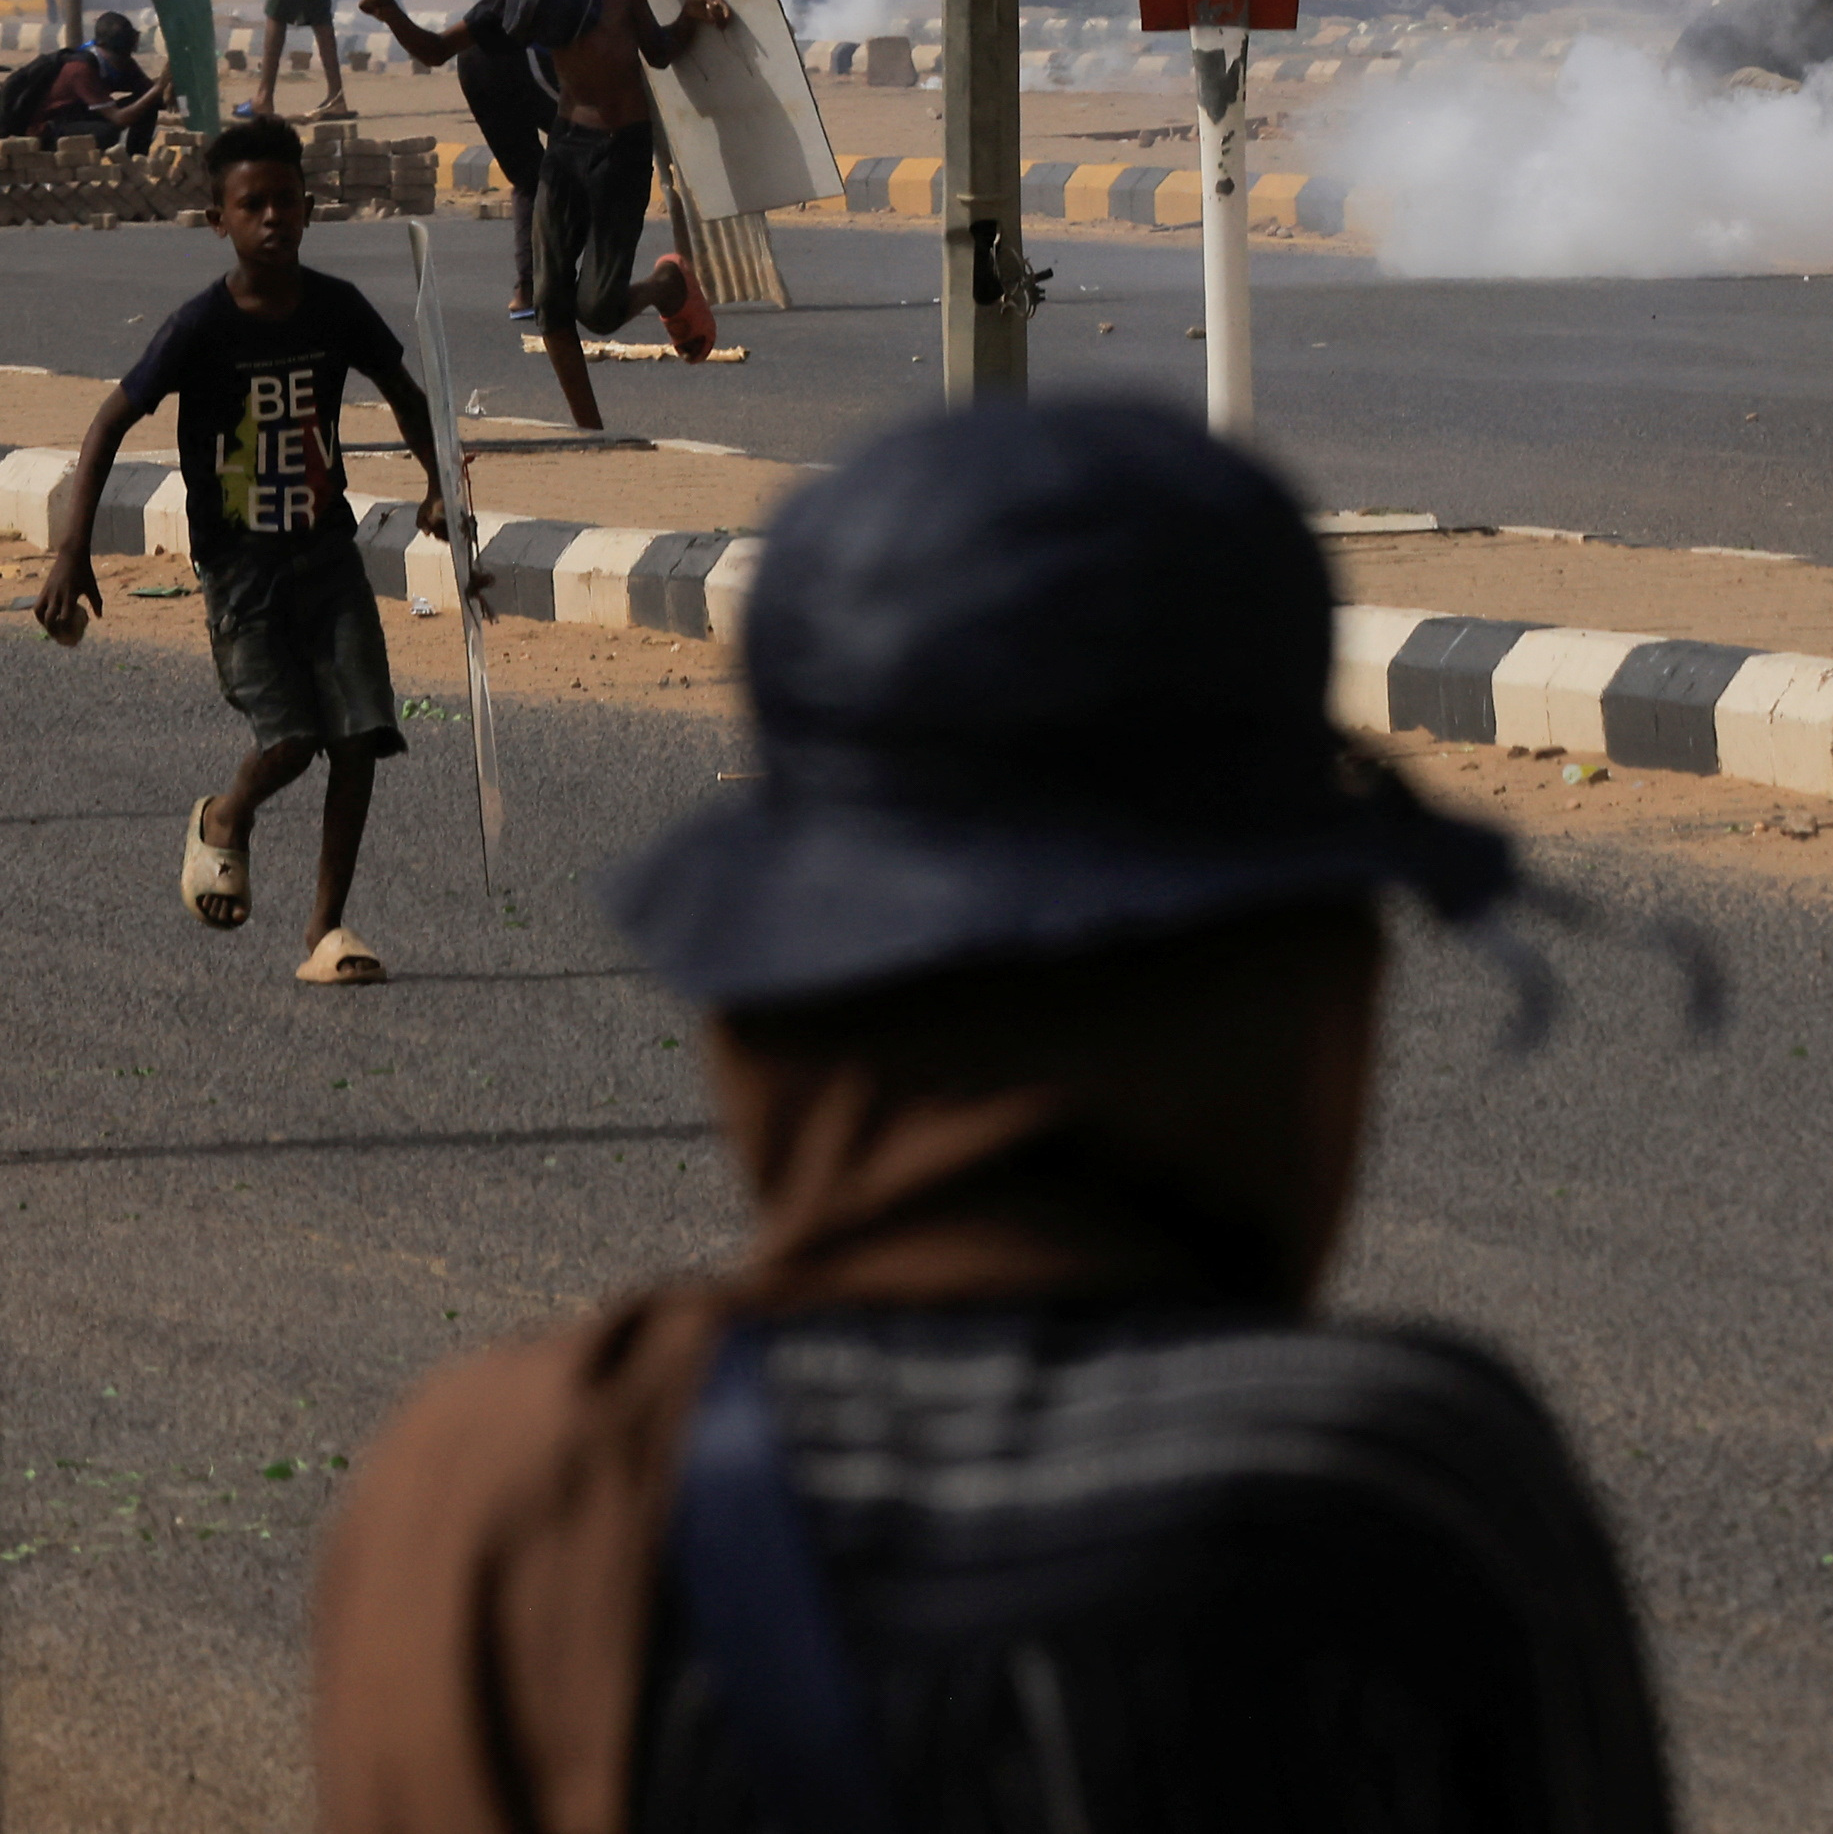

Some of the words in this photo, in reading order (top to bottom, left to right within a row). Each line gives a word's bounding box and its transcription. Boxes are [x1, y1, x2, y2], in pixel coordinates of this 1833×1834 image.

[250, 368, 317, 422] BE
[215, 419, 336, 475] LIEV
[248, 484, 316, 533] ER
